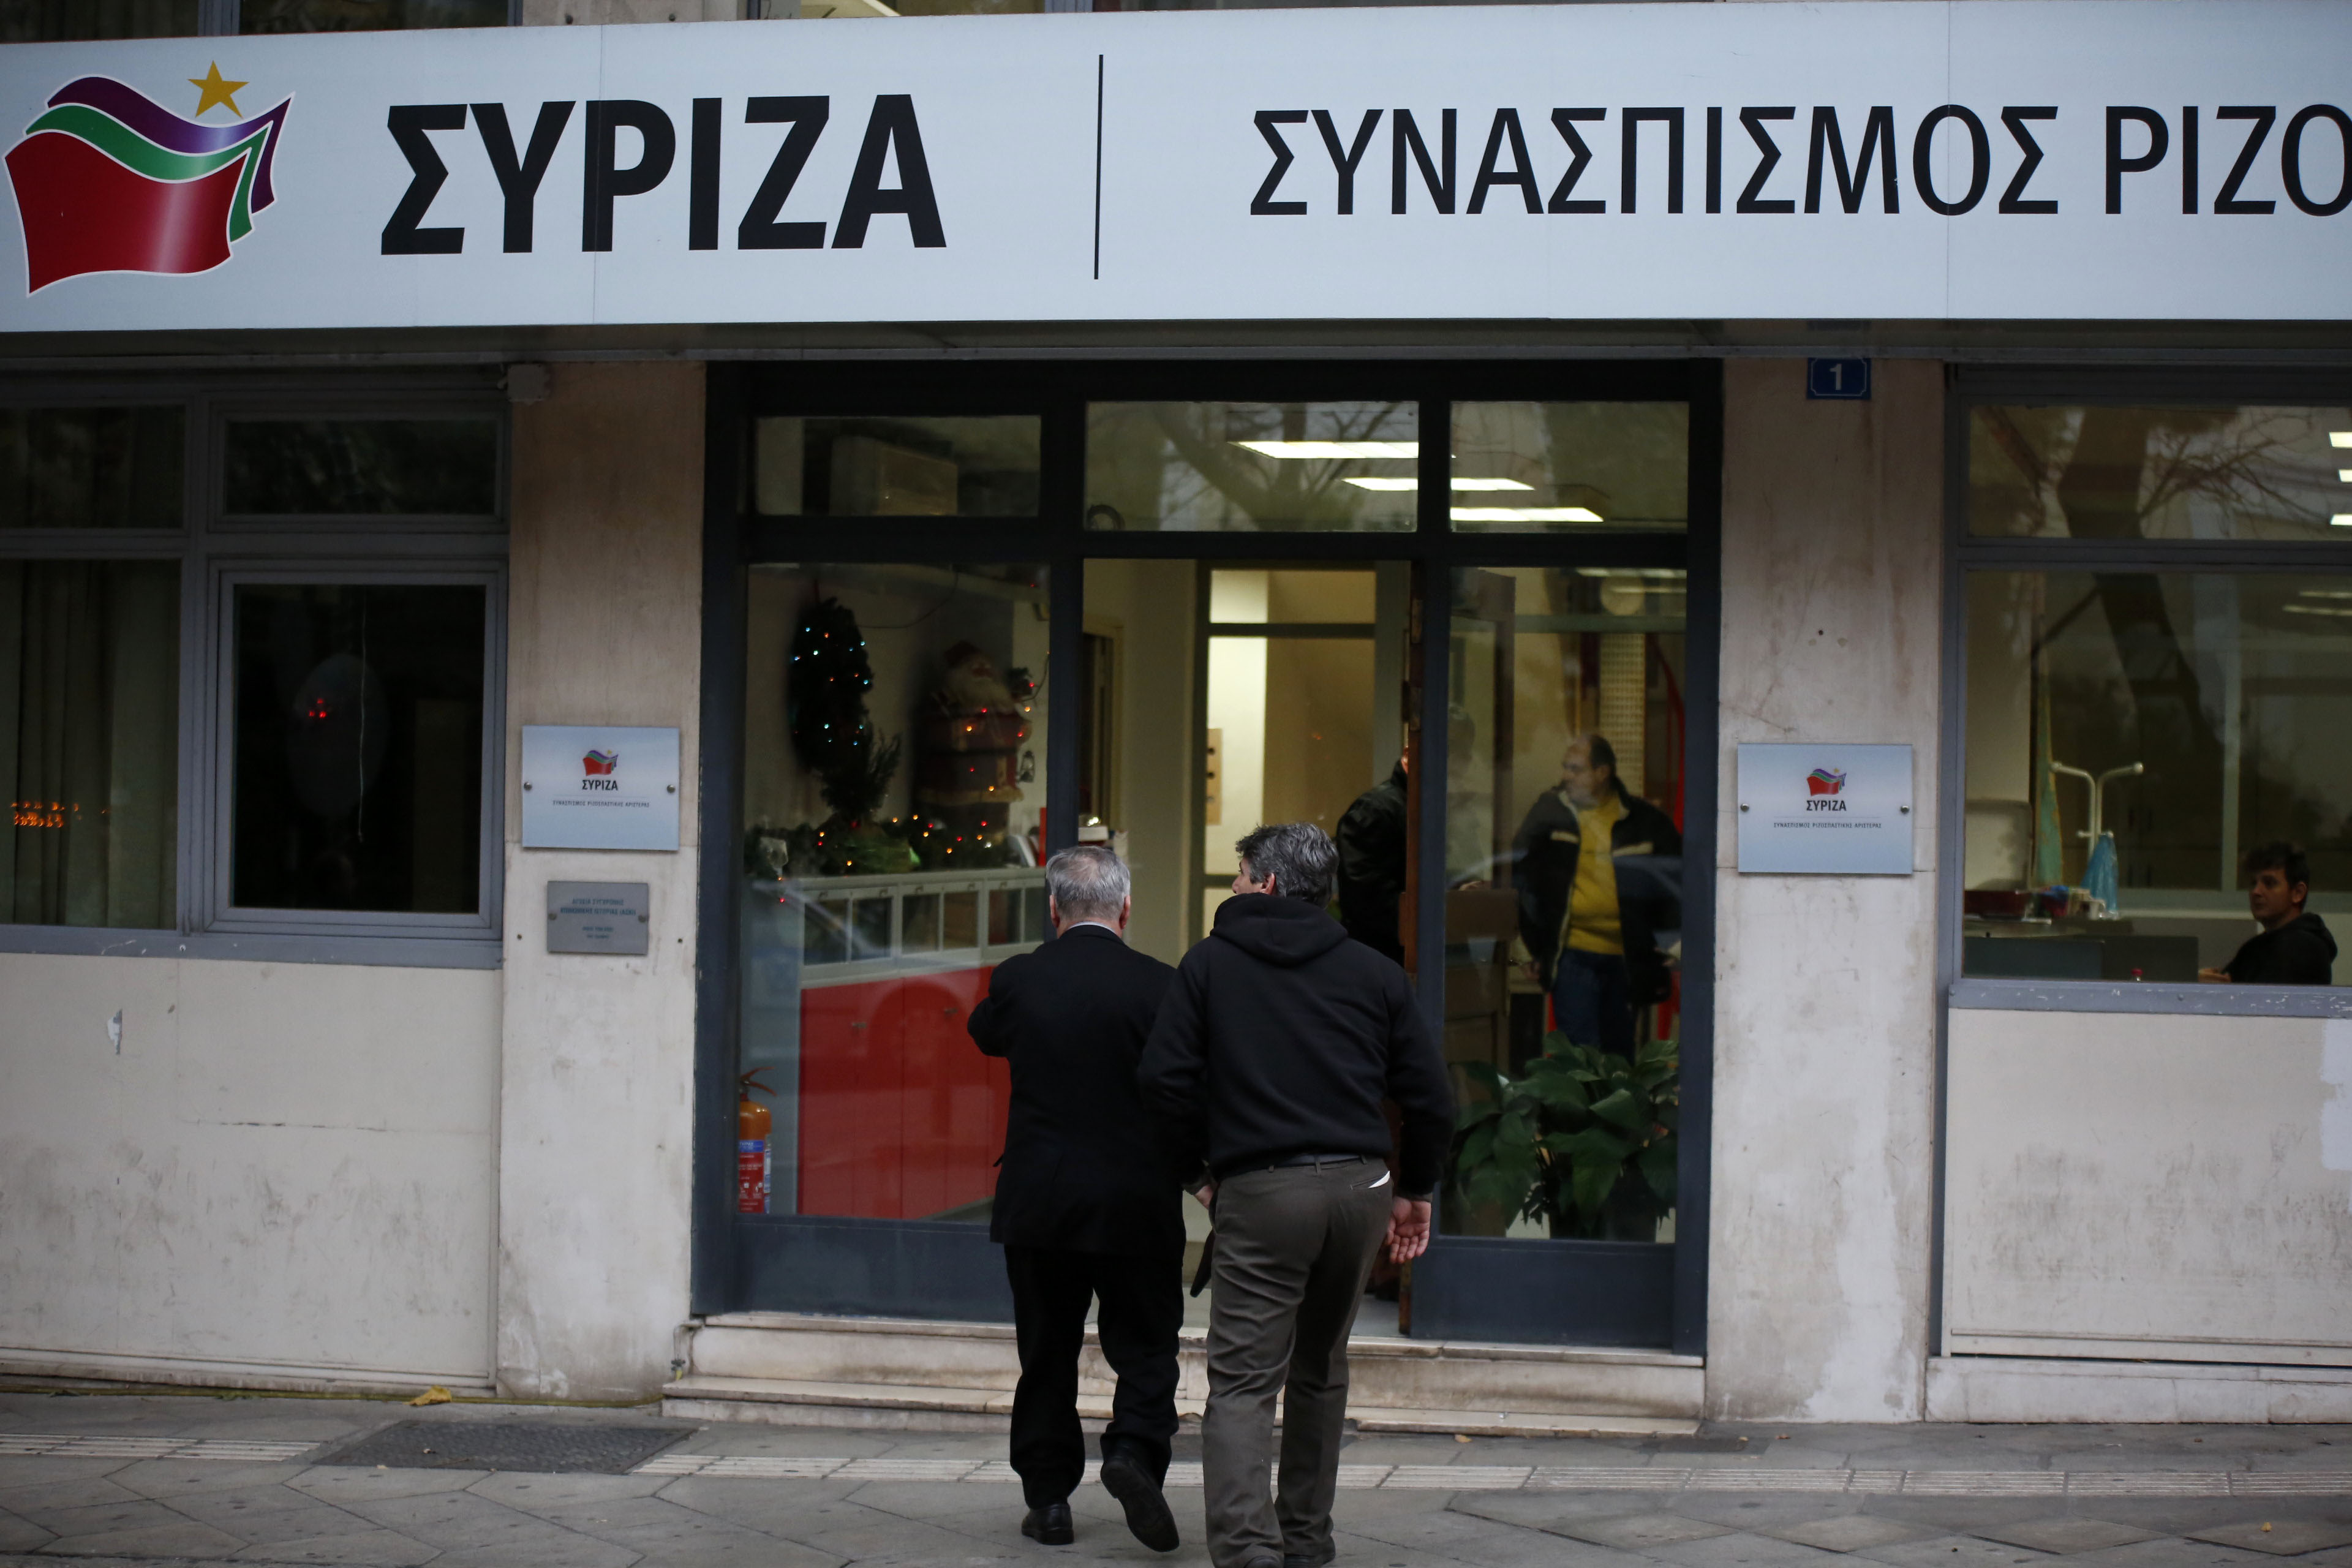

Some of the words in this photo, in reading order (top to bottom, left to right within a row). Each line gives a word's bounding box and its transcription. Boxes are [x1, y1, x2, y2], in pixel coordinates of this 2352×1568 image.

[1251, 104, 2058, 216] ΣΥΝΑΣΠΙΣΜΟΣ
[2106, 104, 2352, 216] ΡΙΖΟ
[382, 94, 946, 255] ΣΥΡΙΖΑ
[1829, 363, 1842, 391] 1
[582, 779, 619, 791] ΣΥΡΙΖΑ
[1806, 800, 1847, 812] ΣΥΡΙΖΑ
